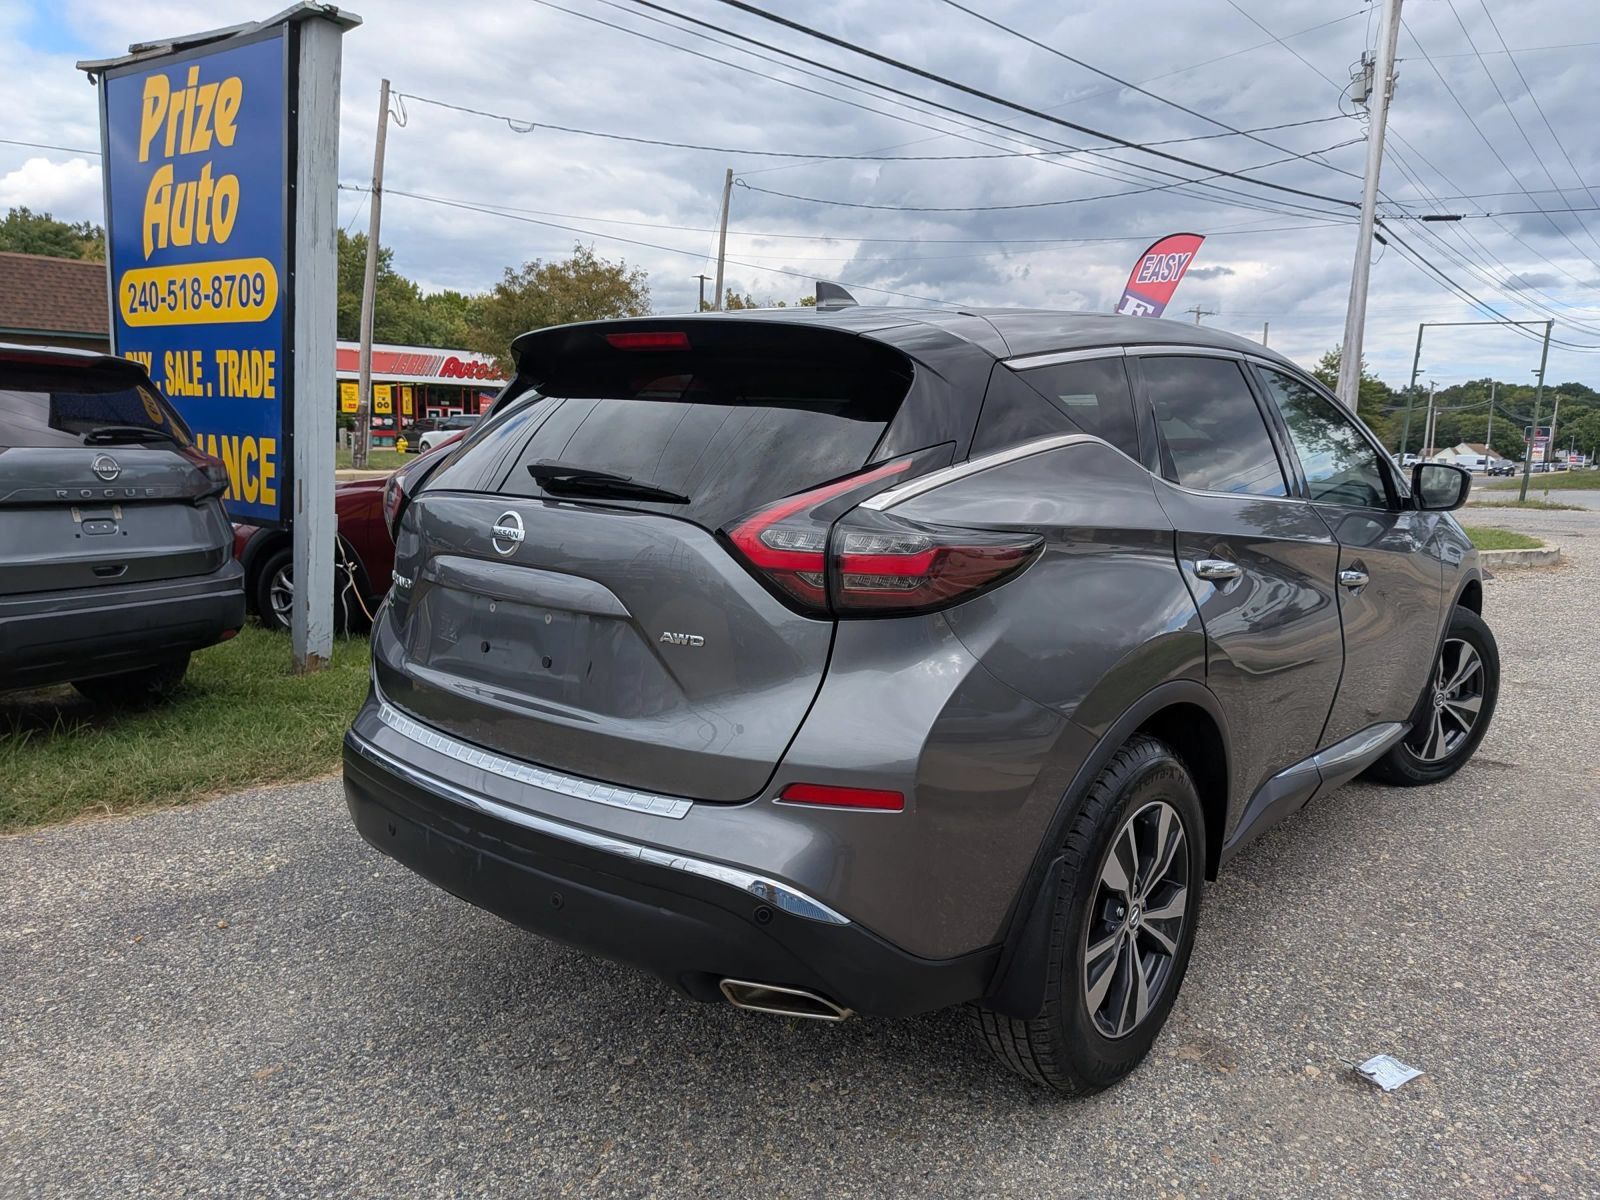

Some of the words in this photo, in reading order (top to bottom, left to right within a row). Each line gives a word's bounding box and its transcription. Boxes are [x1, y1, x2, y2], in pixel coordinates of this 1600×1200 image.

[139, 65, 242, 162] Prize
[142, 161, 240, 261] Auto
[1136, 252, 1192, 283] EASY
[128, 272, 266, 314] 240-518-8709
[216, 349, 276, 399] TRADE
[56, 487, 157, 498] ROGUE
[660, 631, 705, 647] AWD
